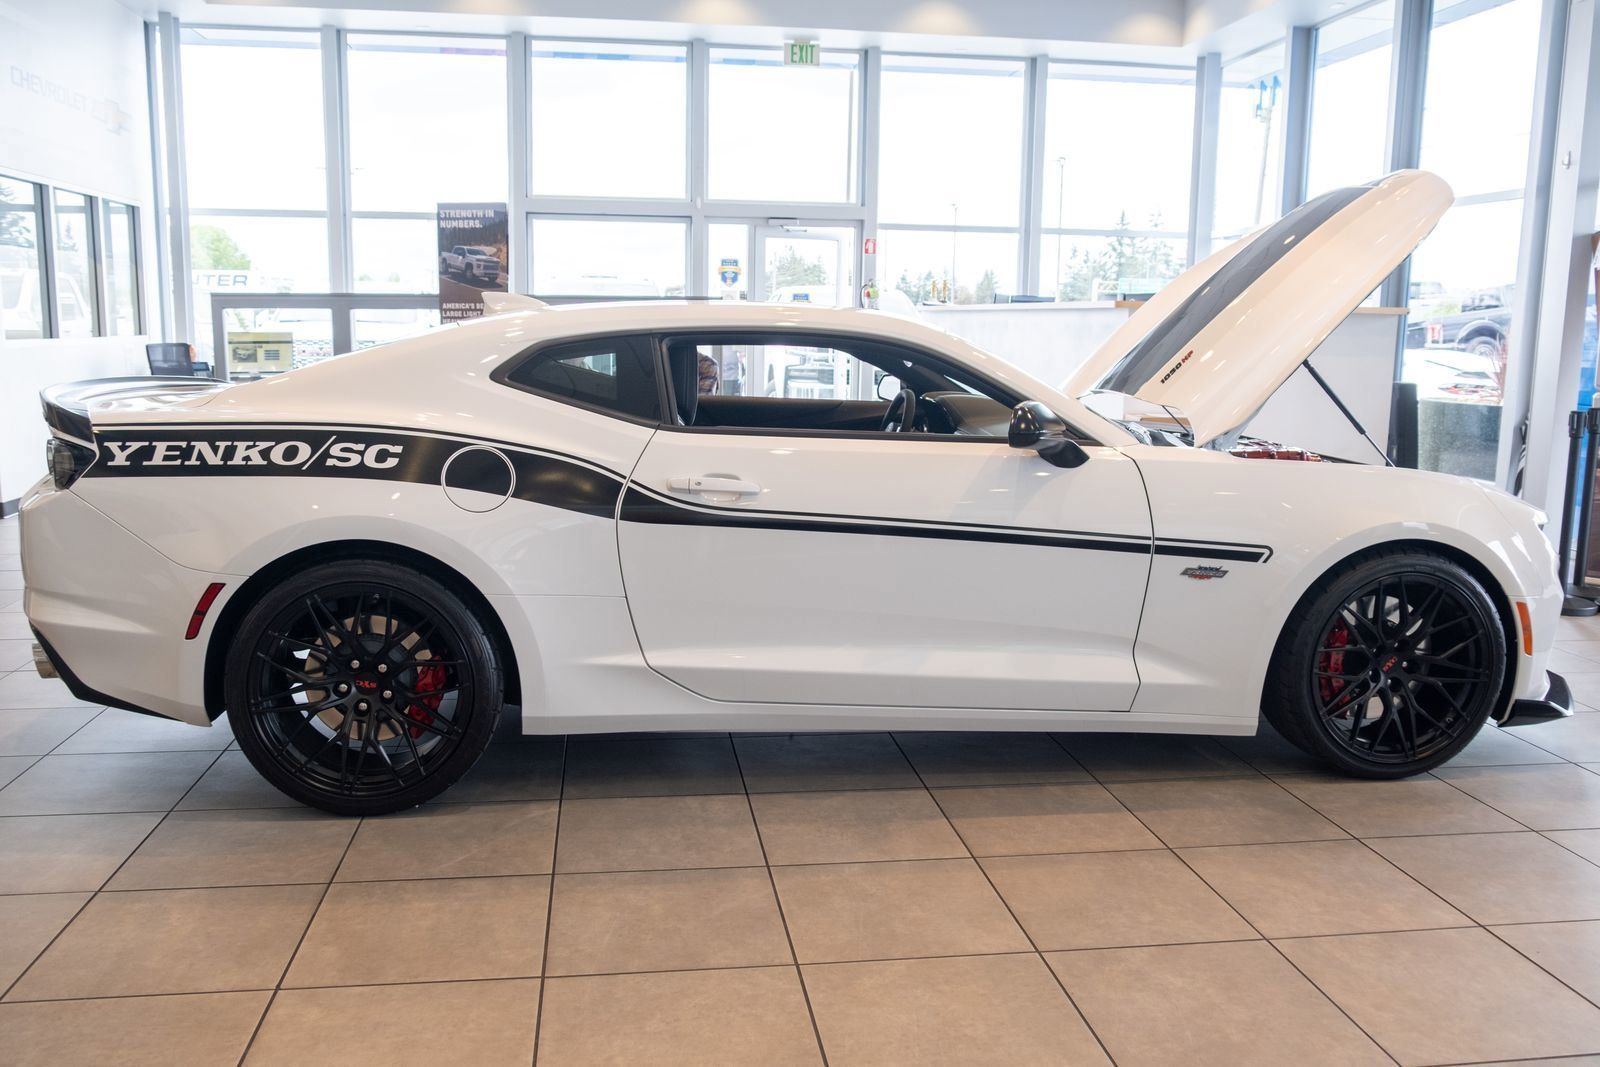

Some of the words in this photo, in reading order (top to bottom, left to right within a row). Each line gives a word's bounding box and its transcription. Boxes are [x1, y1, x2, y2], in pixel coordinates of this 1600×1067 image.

[791, 44, 815, 64] EXIT
[10, 65, 88, 112] CHEVROLET
[440, 209, 483, 218] STRENGTH
[485, 209, 494, 218] IN
[440, 220, 483, 228] NUMBERS.
[1161, 362, 1182, 384] 1050
[1182, 350, 1193, 363] HP
[103, 435, 403, 470] YENKO/SC
